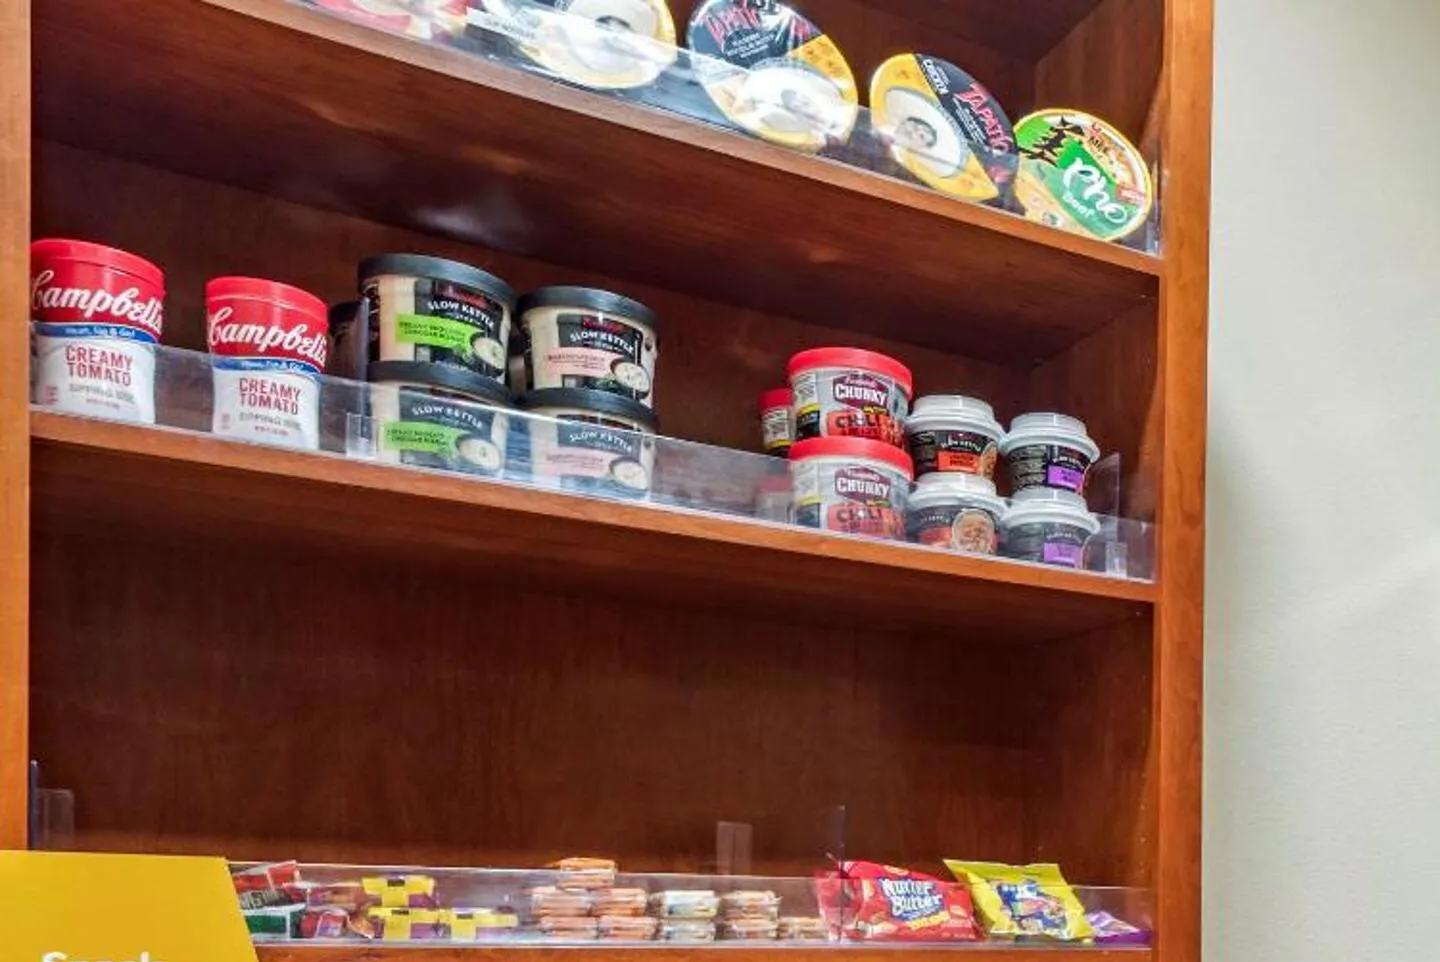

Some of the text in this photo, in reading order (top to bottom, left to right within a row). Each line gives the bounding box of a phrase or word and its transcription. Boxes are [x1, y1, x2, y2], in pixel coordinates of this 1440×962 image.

[66, 345, 134, 370] CREAMY
[67, 362, 132, 387] TOMATO
[239, 377, 302, 400] CREAMY
[835, 383, 888, 406] CHUNKY
[240, 393, 299, 415] TOMATO
[836, 477, 890, 499] CHUNKY
